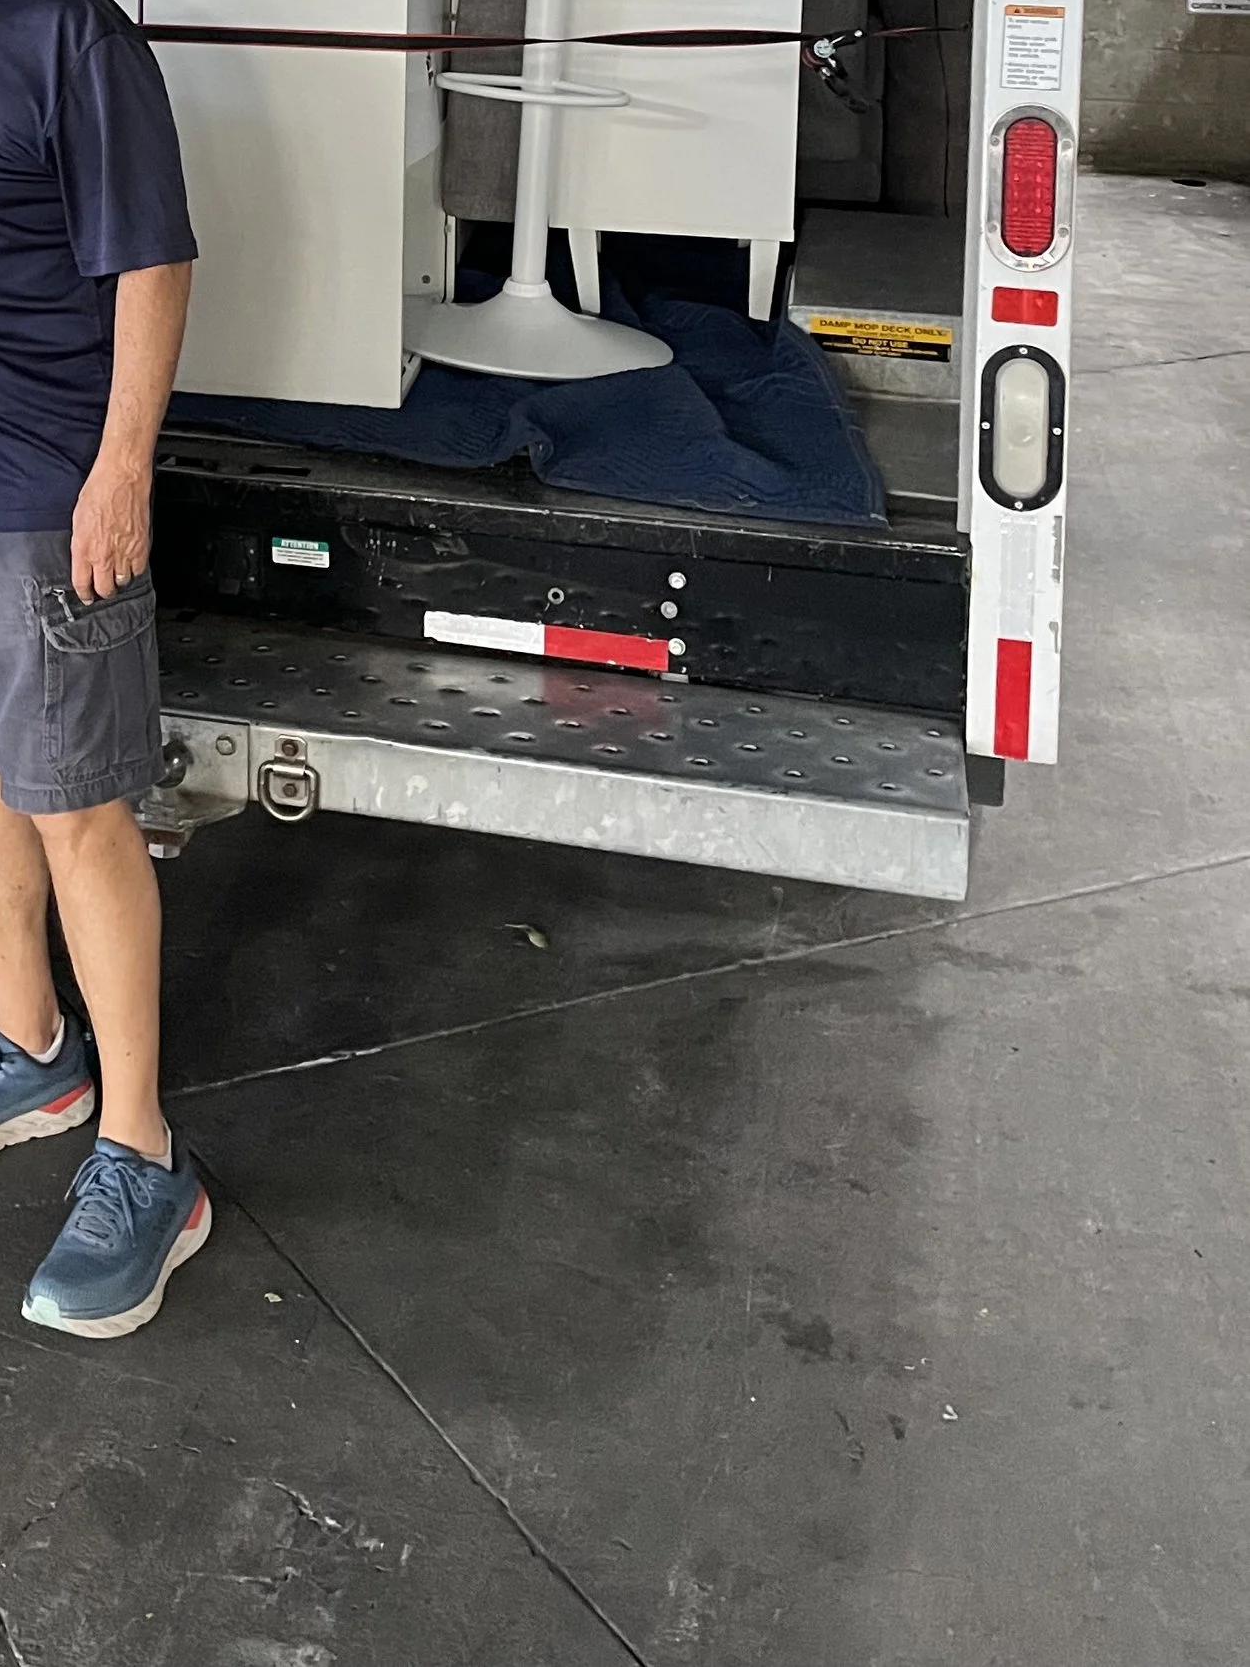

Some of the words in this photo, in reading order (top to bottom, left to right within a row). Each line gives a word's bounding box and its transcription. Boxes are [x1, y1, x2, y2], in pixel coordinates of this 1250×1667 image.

[820, 319, 851, 328] DAMP
[854, 323, 879, 331] MOP
[881, 325, 912, 334] DECK
[852, 337, 867, 345] DO
[281, 539, 319, 550] ATTENTION
